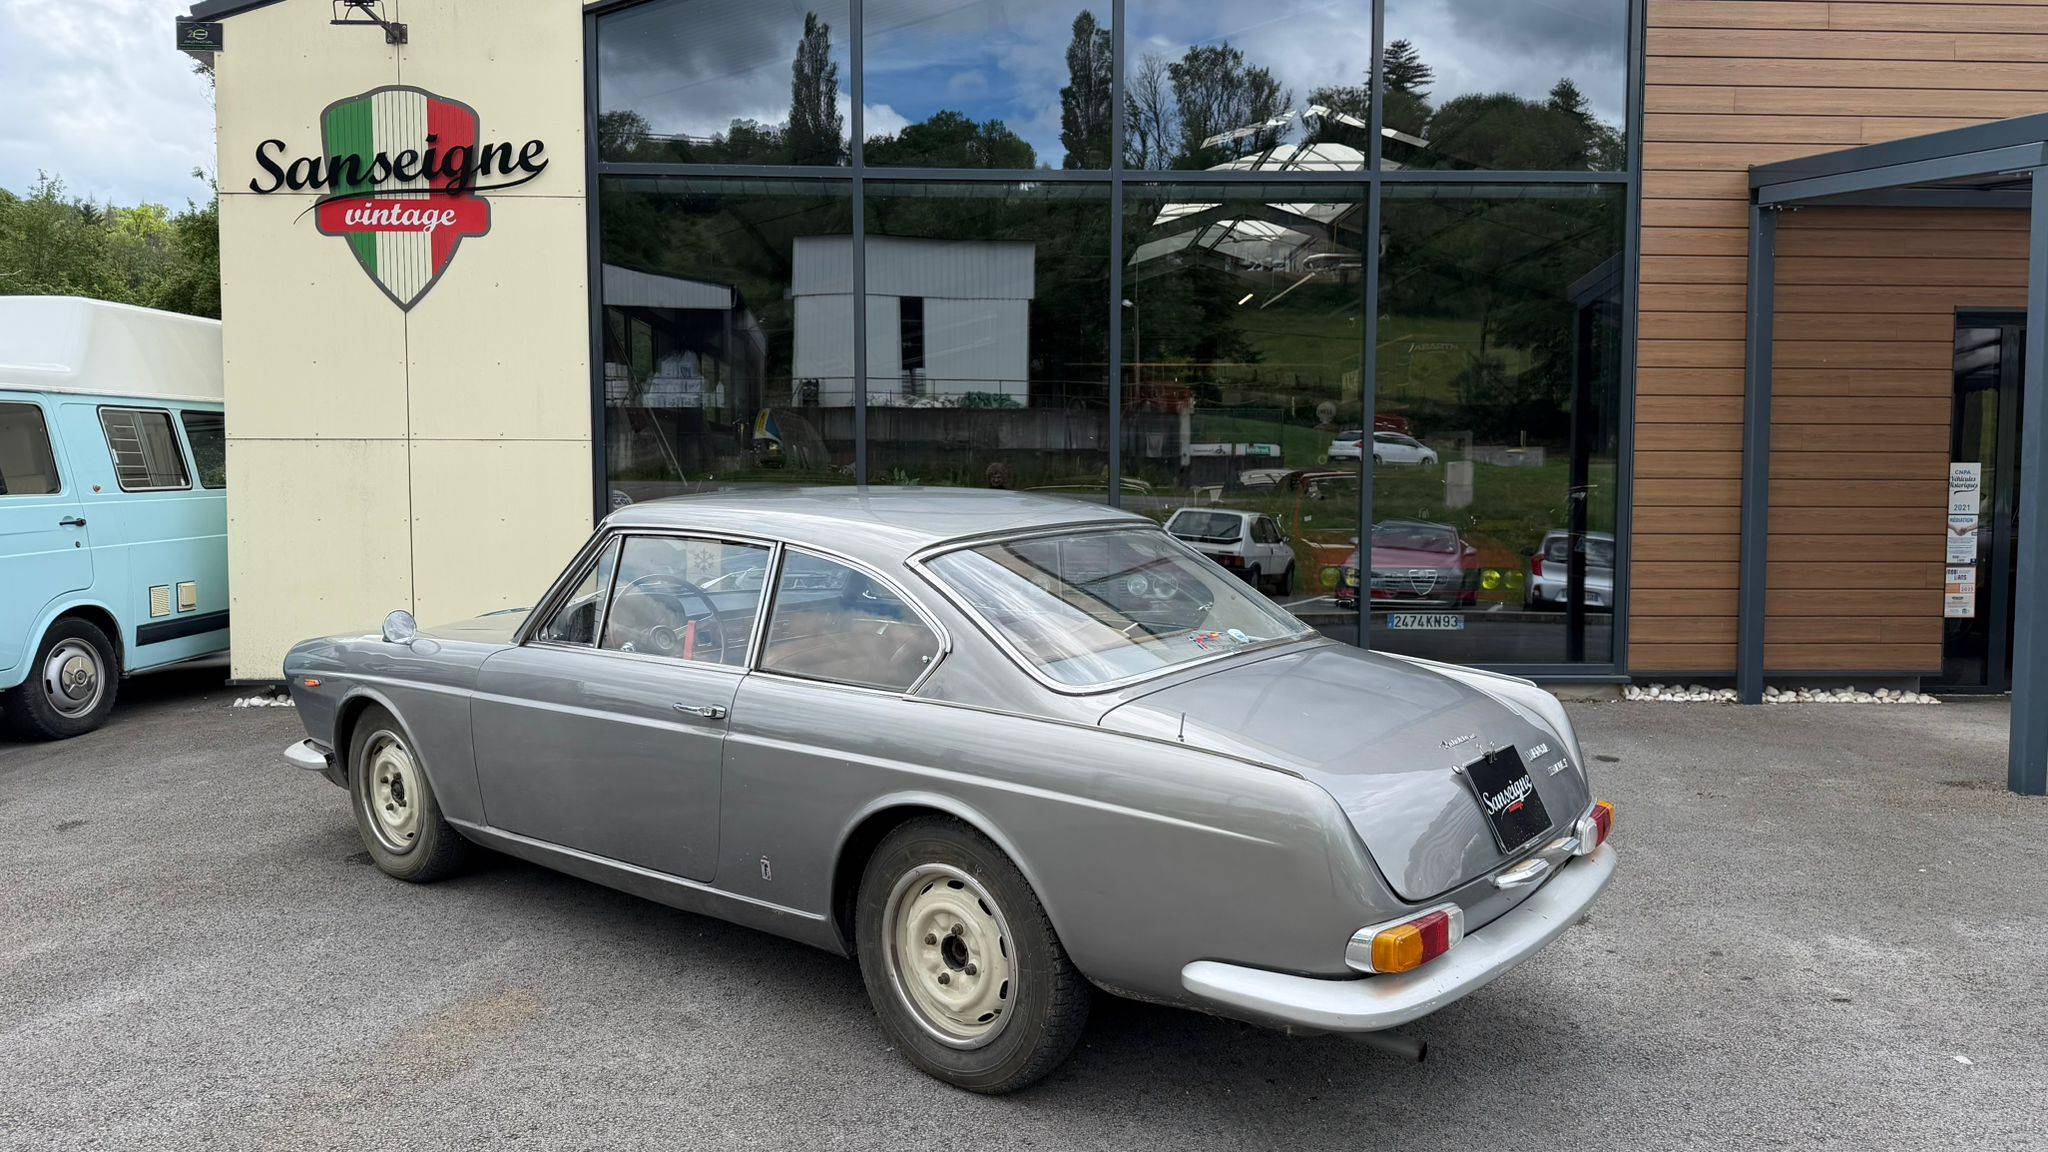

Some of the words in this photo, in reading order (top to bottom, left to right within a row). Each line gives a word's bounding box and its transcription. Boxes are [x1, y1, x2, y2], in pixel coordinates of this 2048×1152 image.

[249, 133, 549, 195] Sanseigne
[344, 202, 456, 233] vintage
[1394, 615, 1458, 628] 2474KN93
[1482, 774, 1533, 815] Sanseigne
